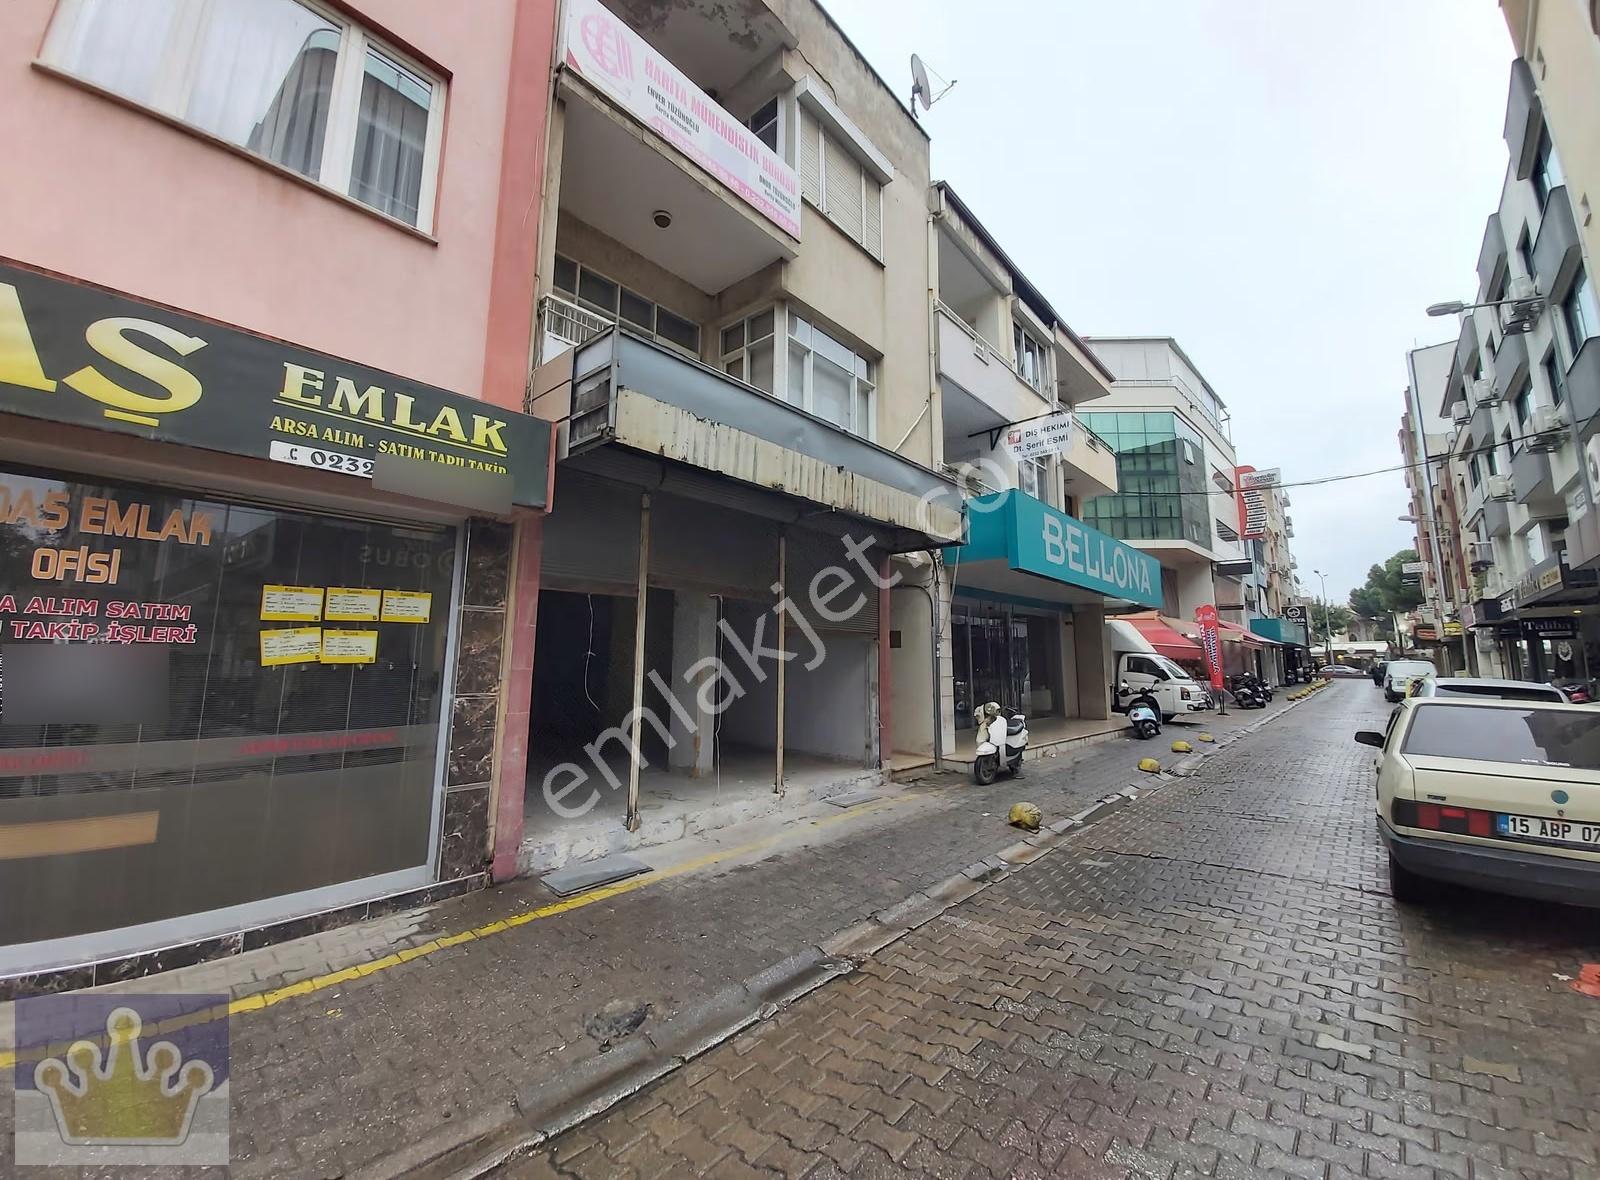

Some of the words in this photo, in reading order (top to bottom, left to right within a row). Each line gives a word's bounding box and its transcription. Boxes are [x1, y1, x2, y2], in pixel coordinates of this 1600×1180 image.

[279, 362, 508, 452] EMLAK
[269, 416, 318, 439] ARSA
[322, 426, 364, 449] ALIM
[378, 440, 425, 460] SATIM
[310, 450, 375, 476] 0232
[80, 497, 213, 546] EMLAK
[1042, 512, 1152, 595] BELLONA
[24, 596, 99, 616] ALIM
[106, 601, 192, 621] SATIM
[11, 619, 99, 641] TAKİP
[107, 620, 198, 645] İŞLERİ
[1510, 817, 1529, 834] 15
[1539, 821, 1571, 839] ABP
